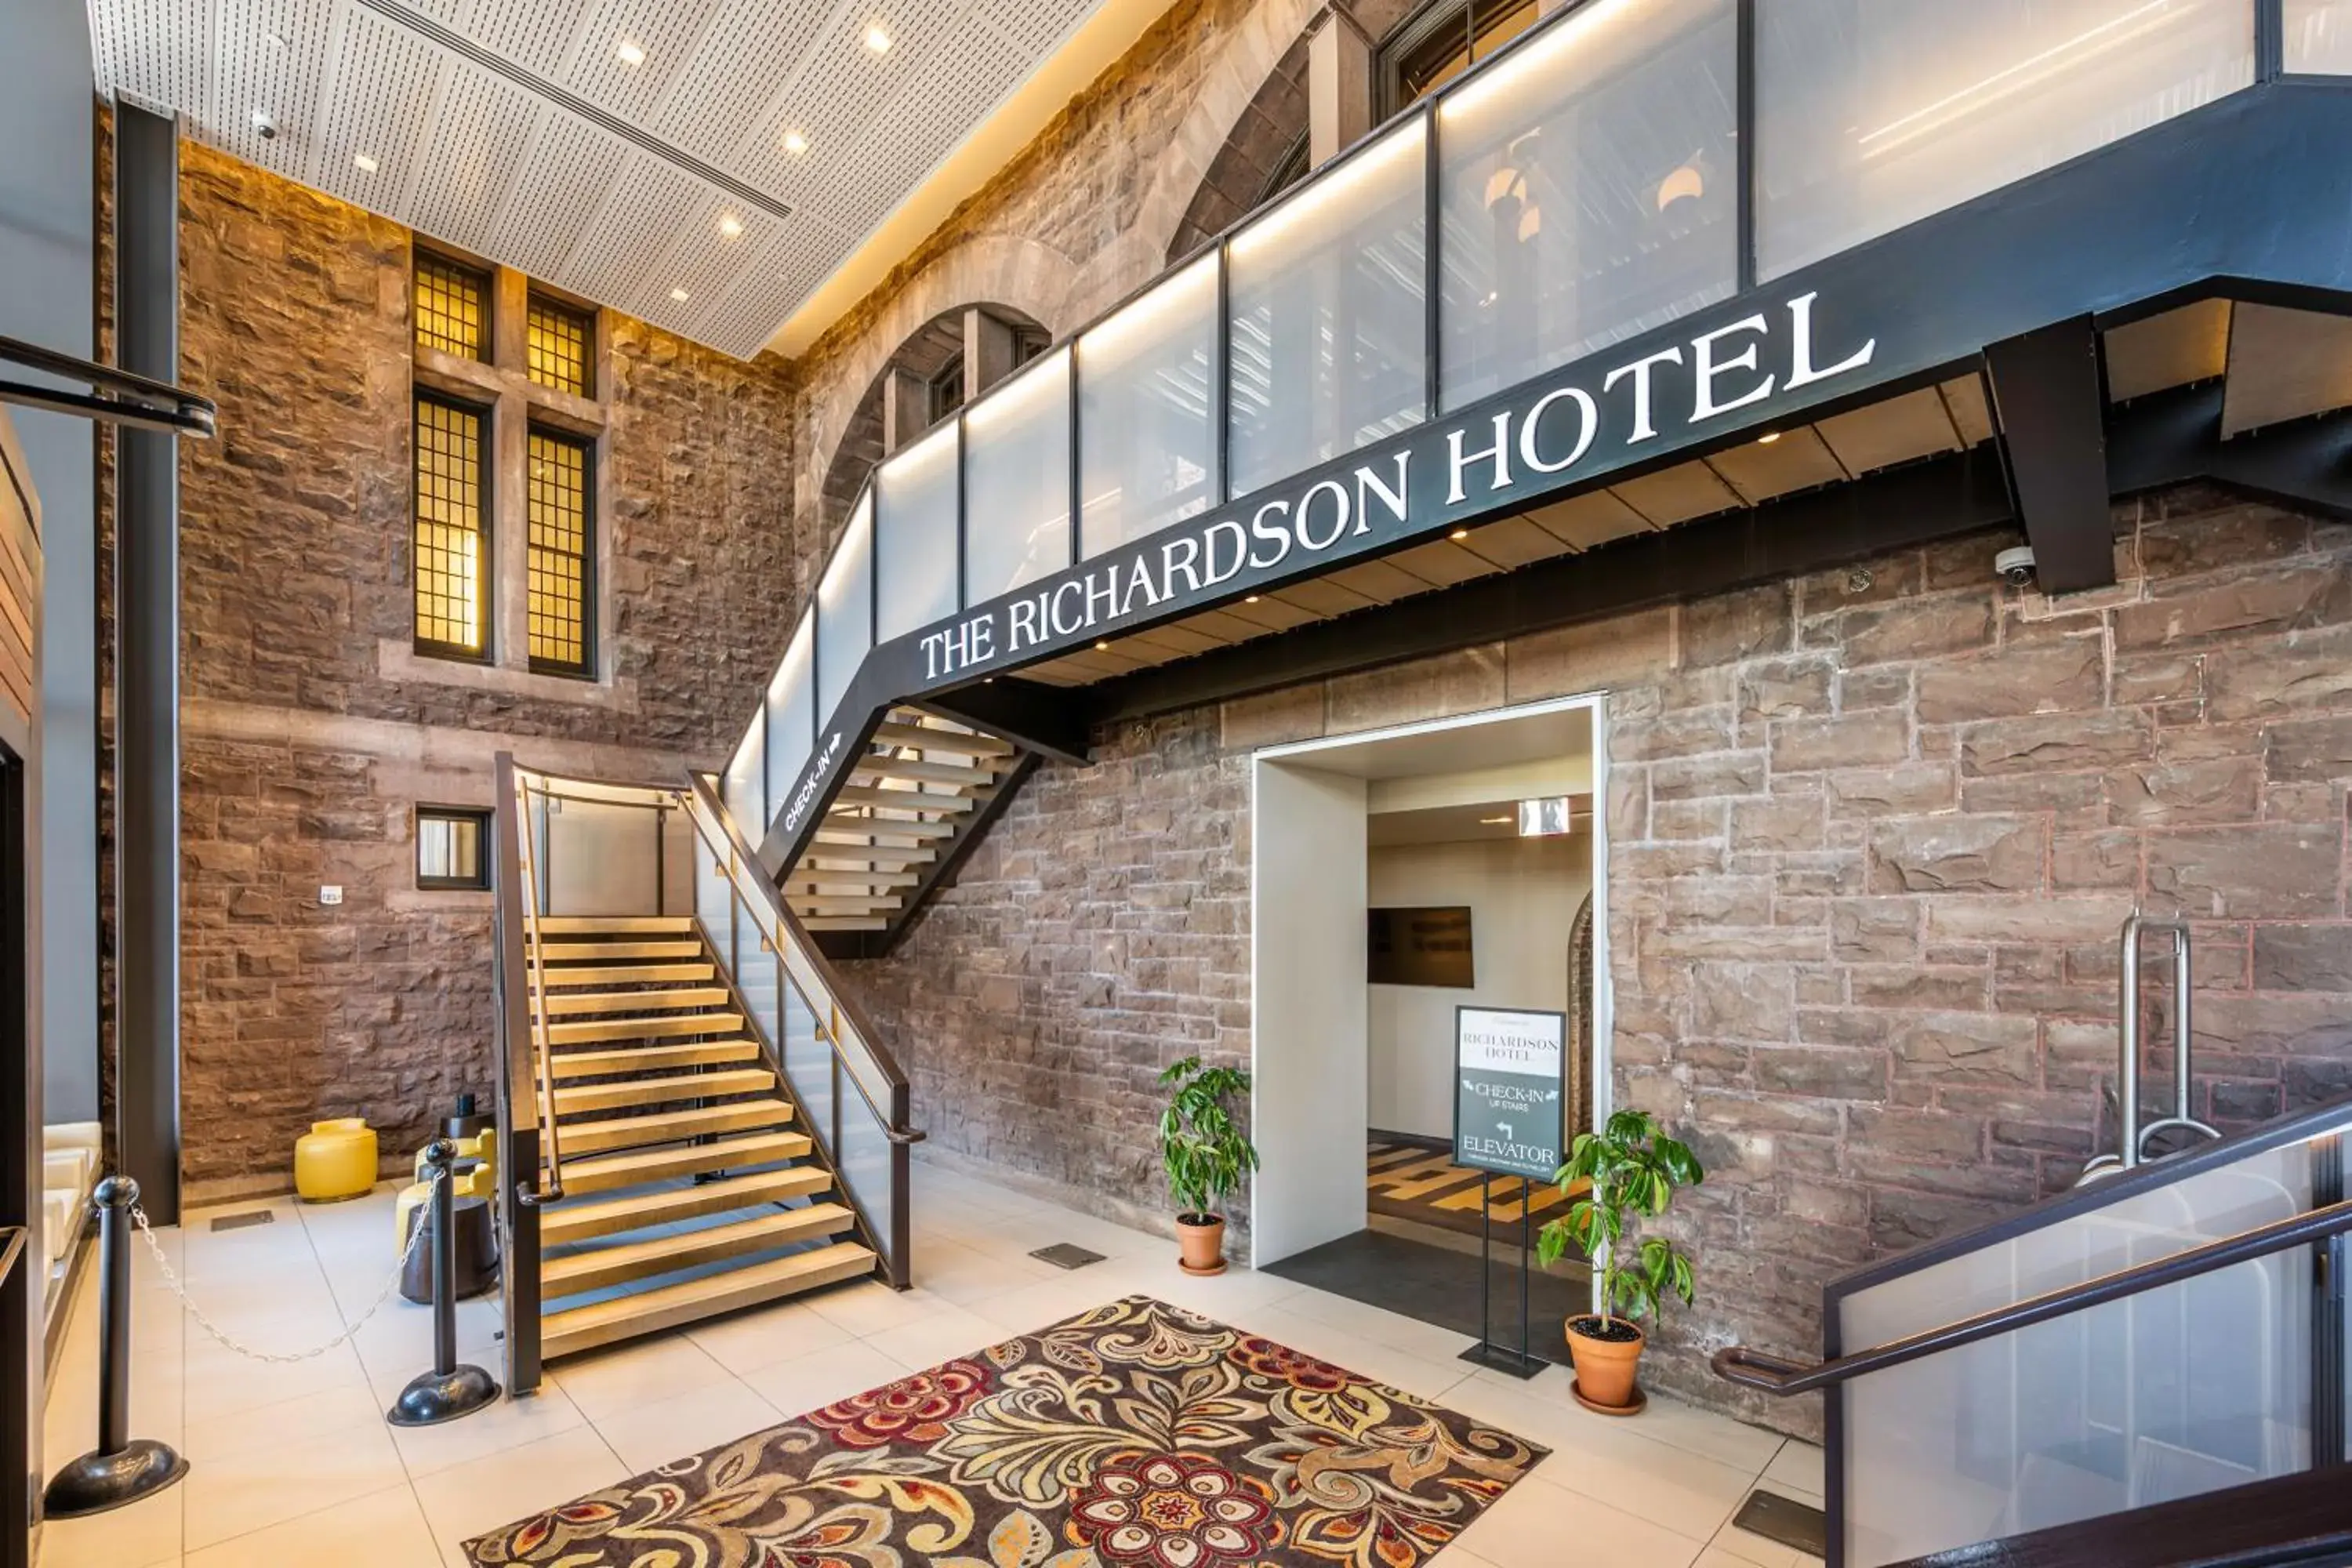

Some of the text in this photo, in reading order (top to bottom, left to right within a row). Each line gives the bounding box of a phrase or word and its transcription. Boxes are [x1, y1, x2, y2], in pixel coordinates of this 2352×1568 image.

[920, 292, 1875, 681] THE RICHARDSON HOTEL
[786, 749, 830, 831] CHECK-IN
[1463, 1033, 1559, 1051] RICHARDSON
[1486, 1047, 1529, 1062] HOTEL
[1475, 1083, 1544, 1102] CHECK-IN
[1464, 1135, 1555, 1165] ELEVATOR
